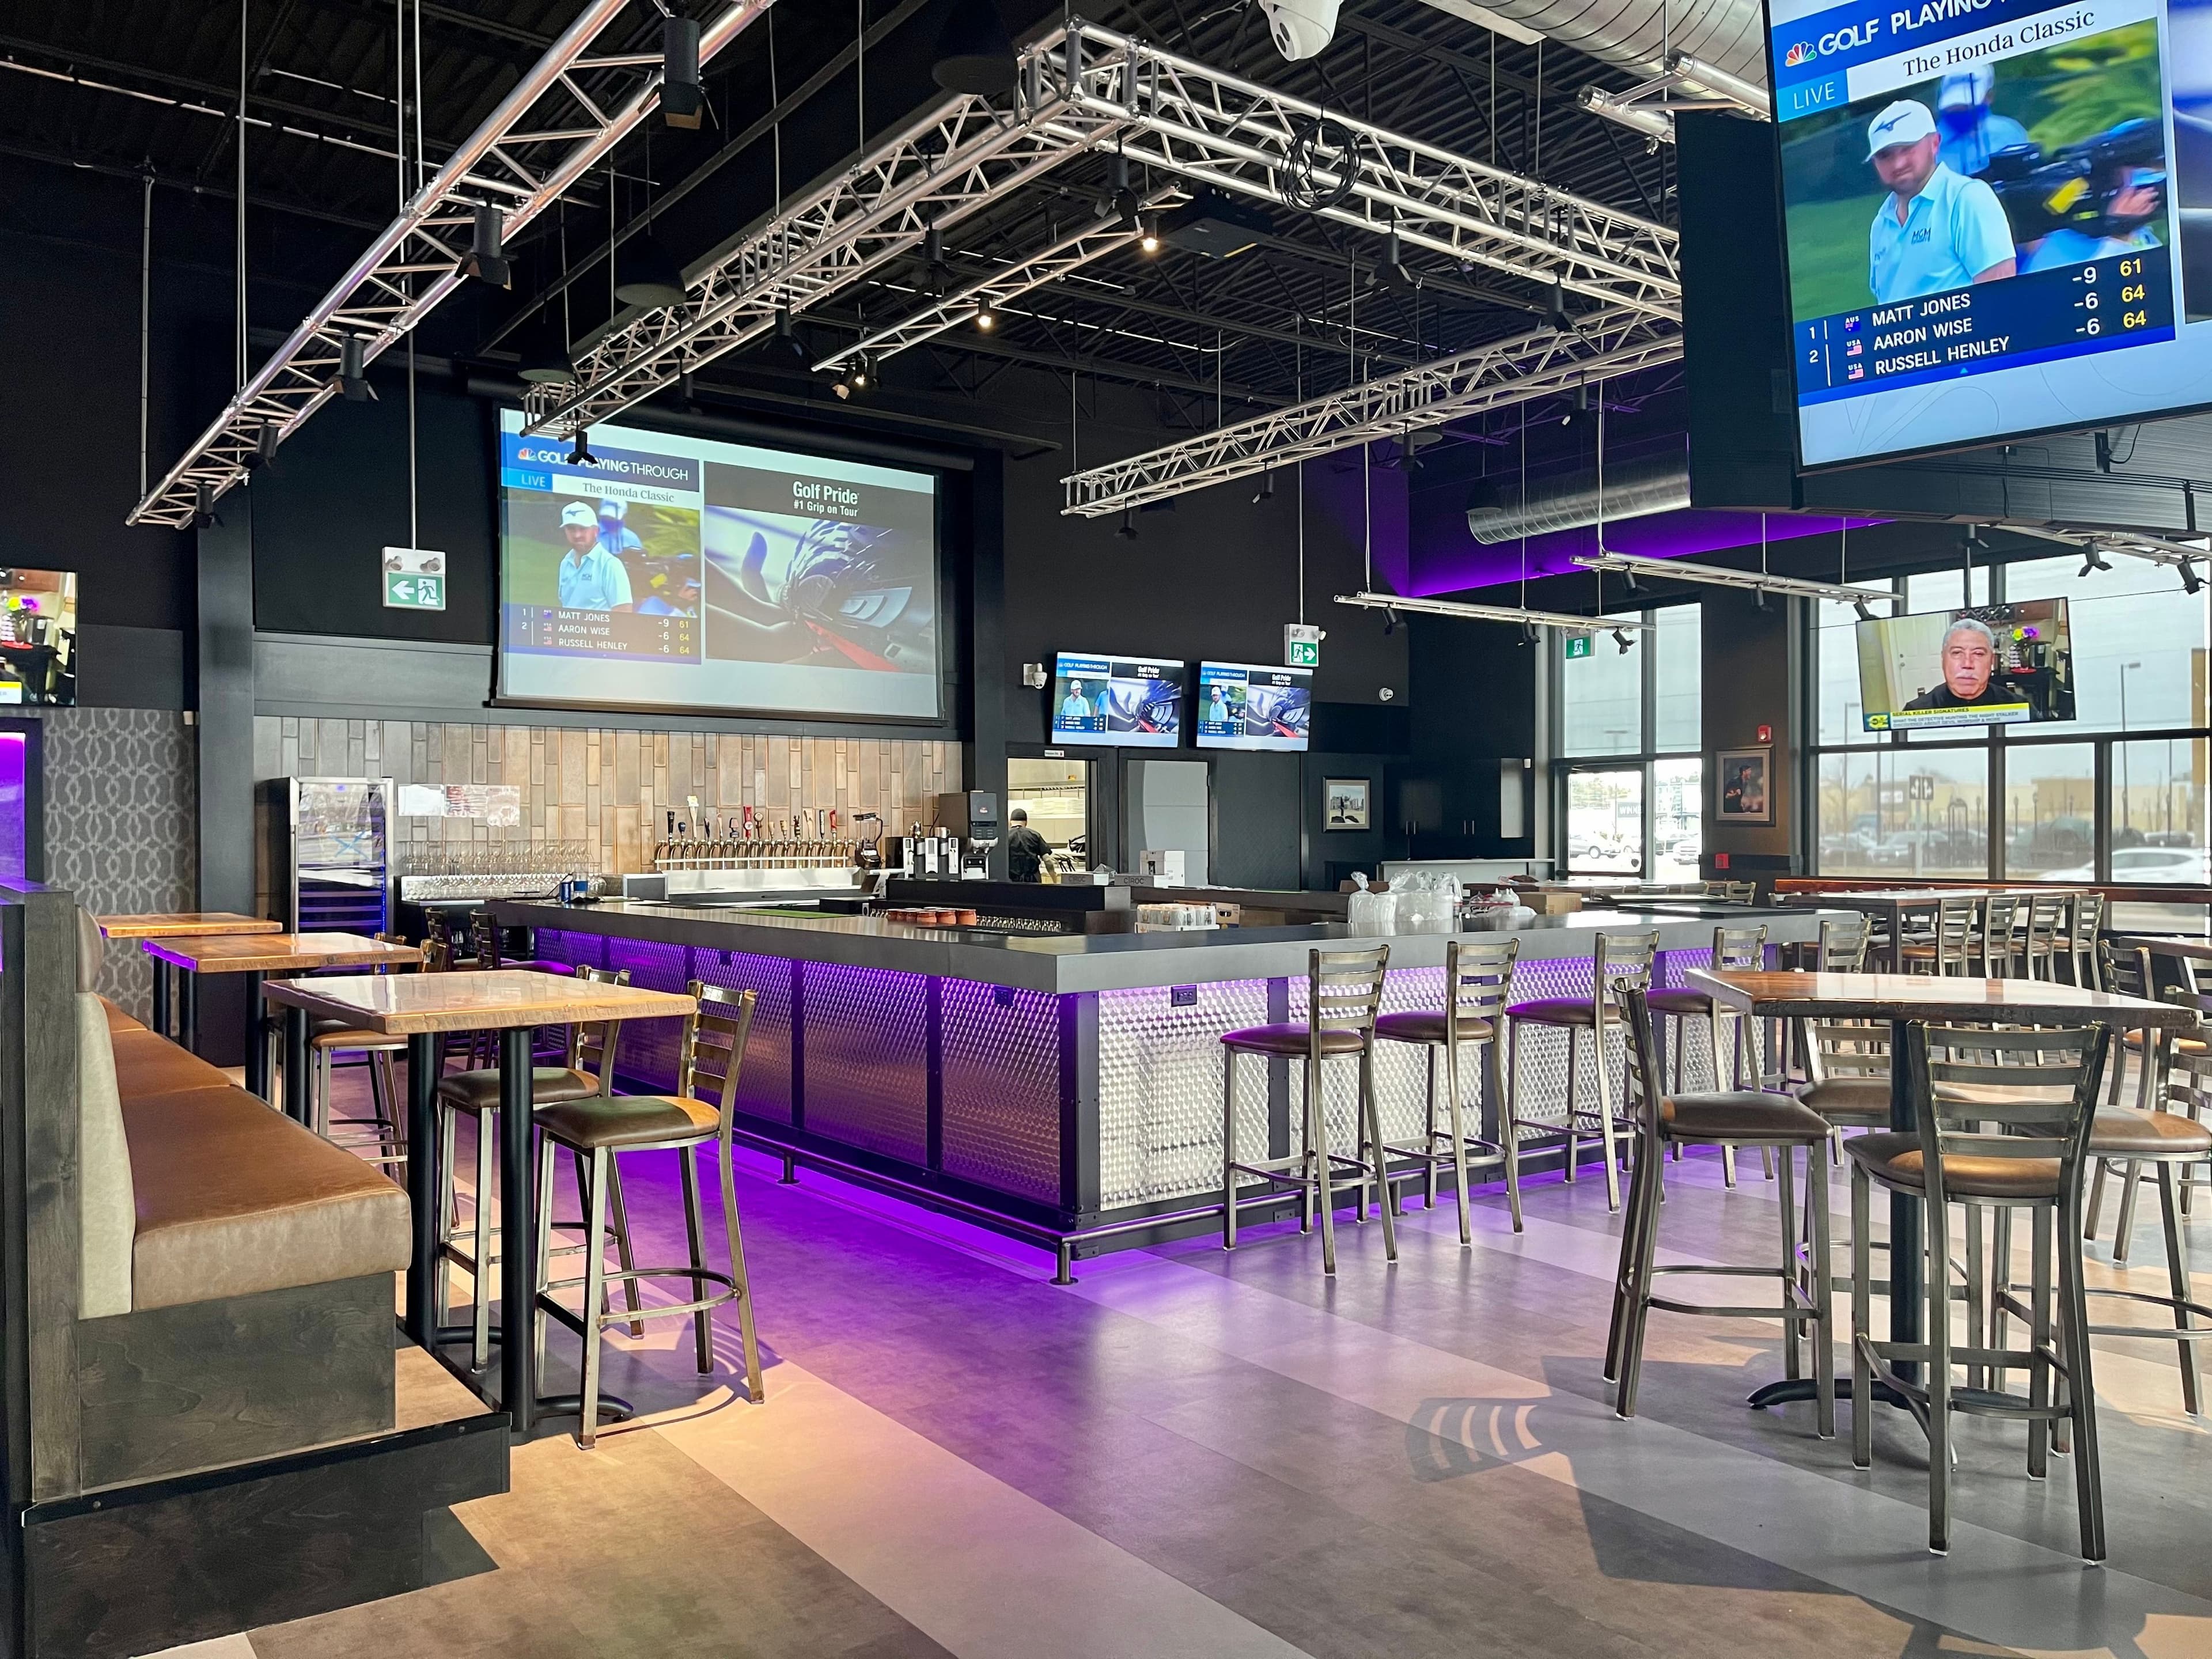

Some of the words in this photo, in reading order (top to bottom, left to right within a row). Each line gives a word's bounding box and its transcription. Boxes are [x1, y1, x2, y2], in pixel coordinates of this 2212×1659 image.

[1819, 18, 1880, 55] GOLF
[1903, 55, 1940, 76] The
[1946, 34, 2014, 66] Honda
[2020, 11, 2094, 43] Classic
[1794, 81, 1835, 109] LIVE
[1809, 327, 1815, 339] 1
[1845, 316, 1859, 324] AUS
[1872, 305, 1914, 327] MATT
[1920, 293, 1971, 317] JONES
[2072, 267, 2097, 283] -9
[2120, 258, 2141, 276] 61
[1809, 350, 1819, 363] 2
[1874, 327, 1926, 350] AARON
[1933, 318, 1972, 338] WISE
[2074, 292, 2099, 309] -6
[2122, 284, 2145, 302] 64
[1876, 350, 1941, 374] RUSSELL
[1948, 336, 2010, 362] HENLEY
[2075, 318, 2100, 335] -6
[2123, 310, 2146, 328] 64
[521, 474, 546, 487] LIVE
[630, 462, 688, 480] THROUGH
[582, 483, 602, 493] The
[605, 486, 637, 498] Honda
[641, 491, 674, 502] Classic
[793, 481, 820, 499] Golf
[823, 486, 858, 505] Pride
[794, 499, 804, 509] #1
[807, 501, 824, 514] Grip
[827, 506, 837, 514] on
[840, 505, 858, 517] Tour
[558, 611, 581, 620] MATT
[584, 613, 609, 622] JONES
[658, 619, 669, 627] -9
[679, 620, 689, 628] 61
[558, 624, 587, 634] AARON
[590, 627, 610, 635] WISE
[658, 632, 669, 641] -6
[679, 634, 690, 642] 64
[559, 638, 594, 649] RUSSELL
[597, 641, 627, 650] HENLEY
[658, 645, 669, 653] -6
[679, 646, 690, 654] 64
